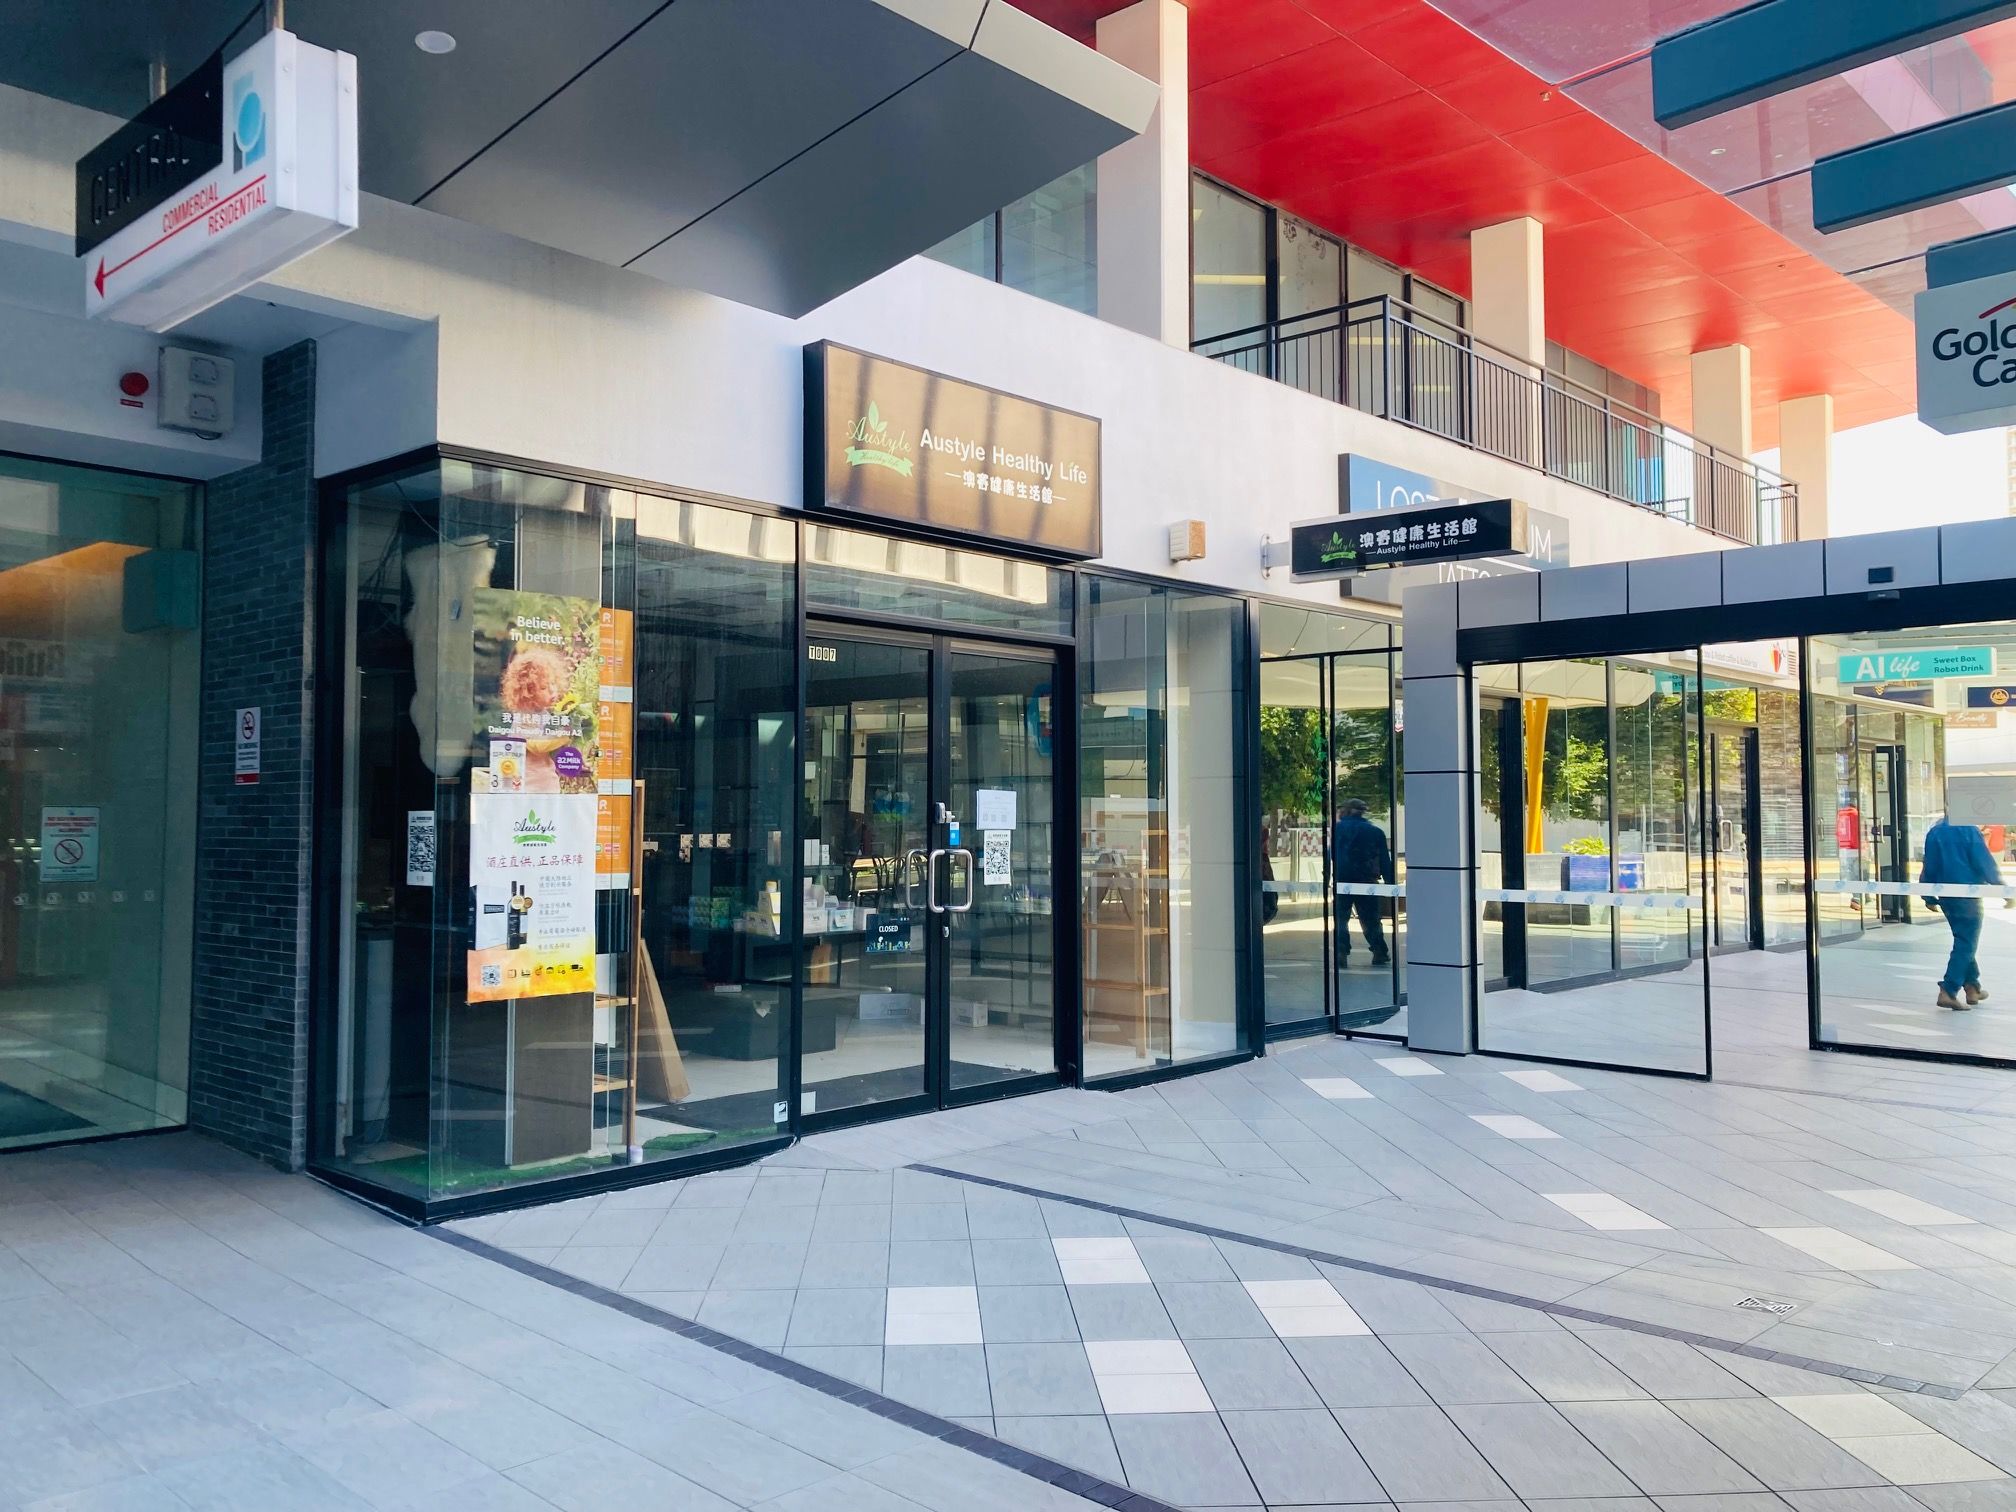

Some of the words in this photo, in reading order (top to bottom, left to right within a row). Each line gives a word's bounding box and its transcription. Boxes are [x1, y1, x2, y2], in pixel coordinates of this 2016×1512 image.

[162, 181, 219, 233] COMMERCIAL
[207, 184, 267, 236] RESIDENTIAL
[845, 416, 912, 456] Austyle
[919, 428, 986, 462] Austyle
[992, 445, 1053, 481] Healthy
[1060, 462, 1087, 485] Life
[1376, 544, 1407, 555] Austyle
[1409, 540, 1440, 550] Healthy
[1443, 537, 1459, 546] Life
[517, 615, 561, 630] Believe
[510, 629, 522, 641] in
[525, 631, 565, 646] better.
[1856, 656, 1885, 679] AI
[1889, 655, 1921, 678] life
[1933, 656, 1959, 664] Sweet
[1960, 655, 1976, 663] Box
[1961, 665, 1984, 673] Drink
[488, 726, 514, 736] Daigou
[545, 728, 571, 737] Daigou
[571, 729, 583, 737] A2
[513, 817, 557, 834] Austyle
[878, 925, 899, 933] CLOSED
